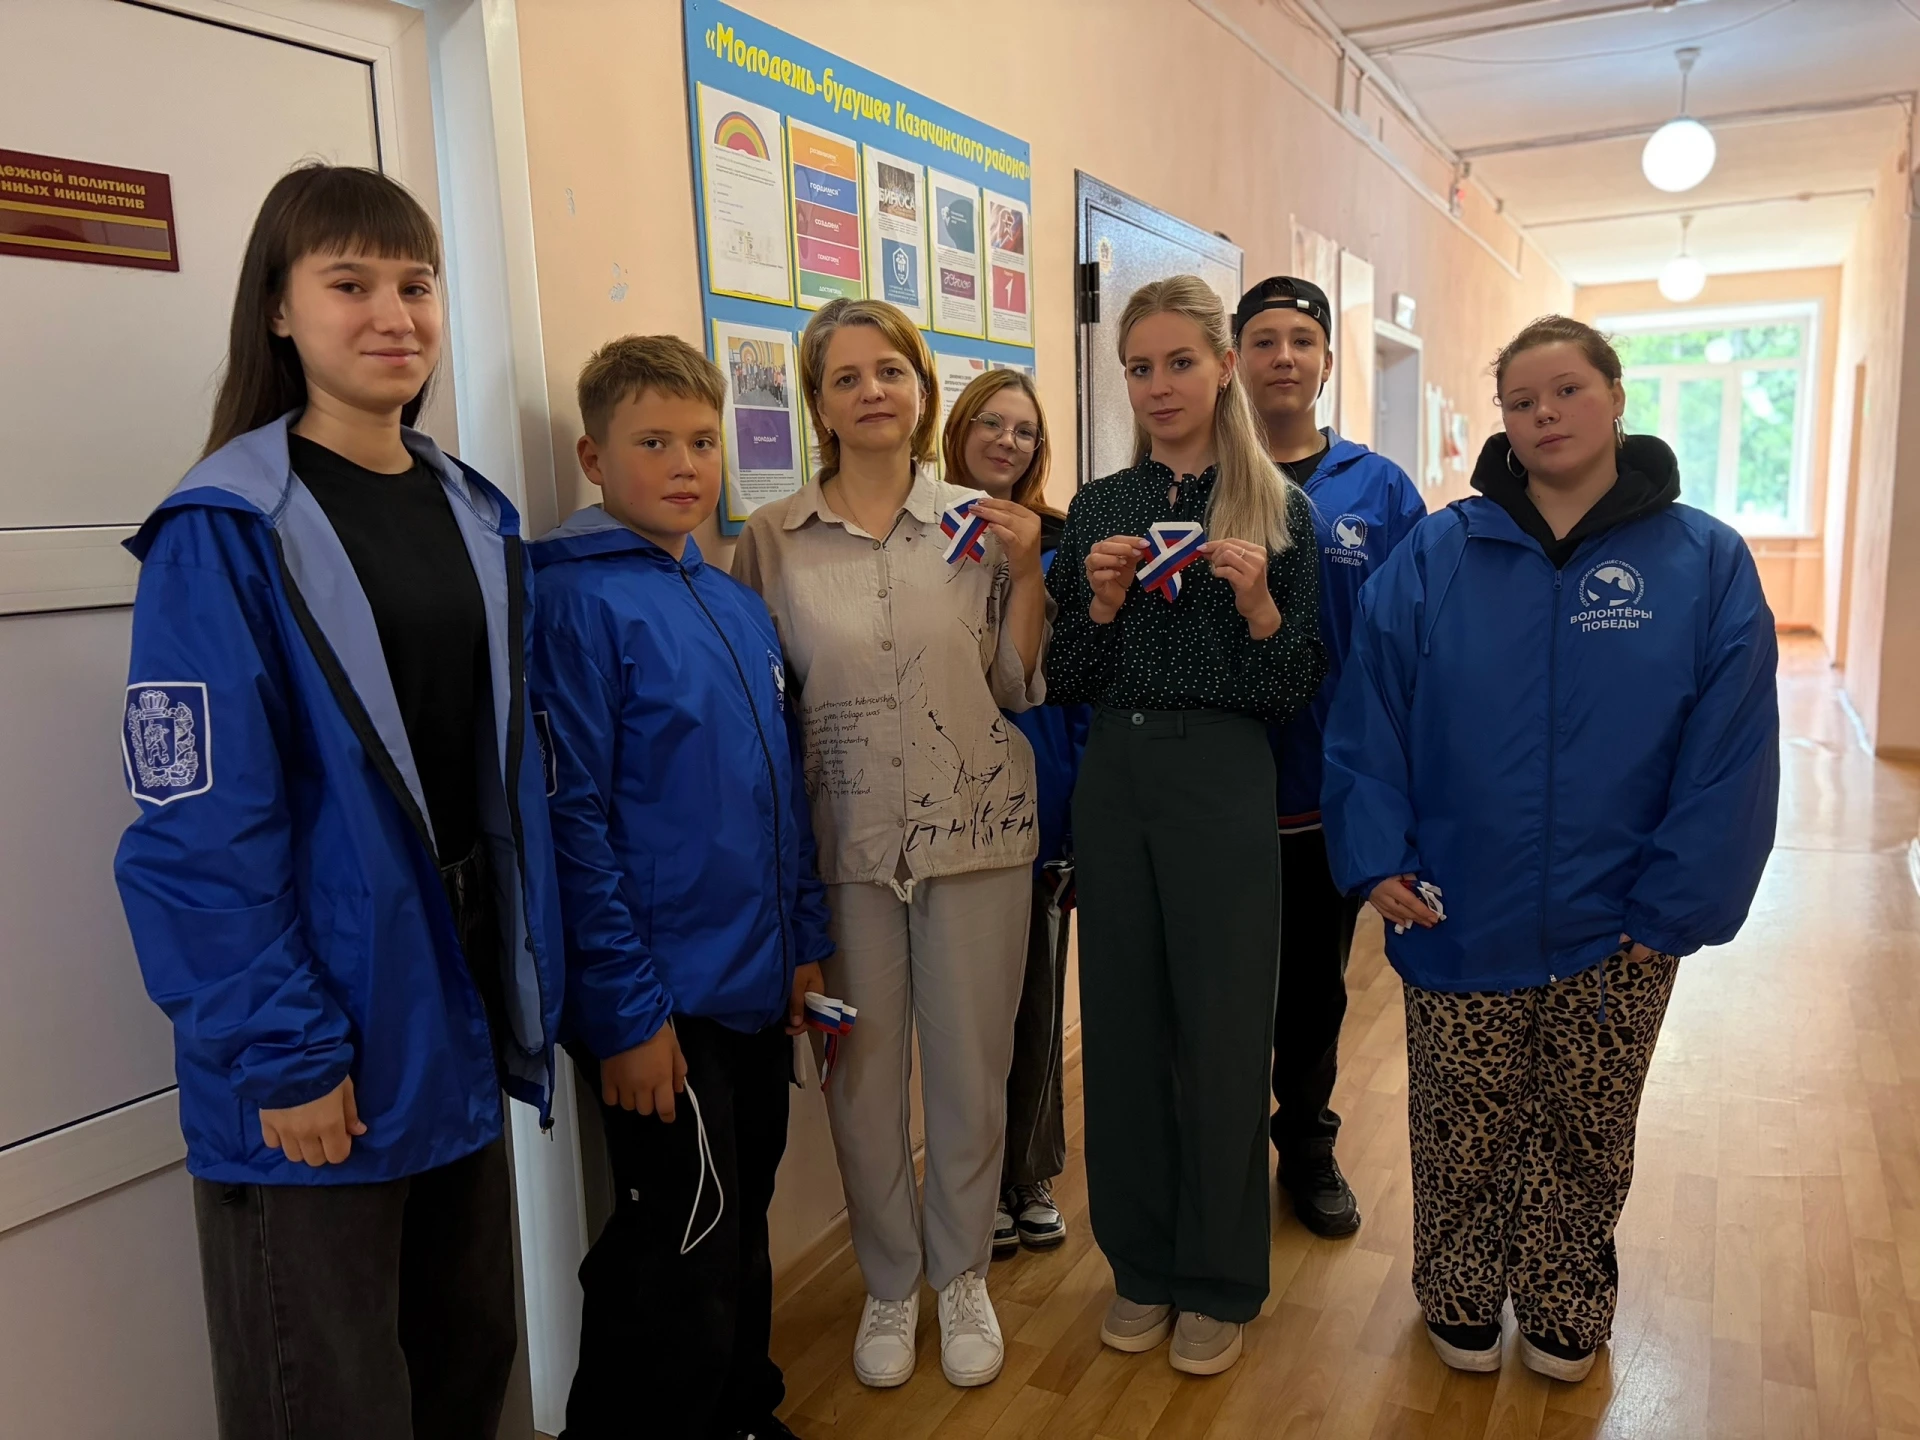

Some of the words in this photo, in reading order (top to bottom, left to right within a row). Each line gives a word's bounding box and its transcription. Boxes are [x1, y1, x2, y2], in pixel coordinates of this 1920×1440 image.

[895, 100, 984, 167] Казачинского
[68, 174, 146, 196] политики
[810, 182, 839, 196] гордимся
[0, 180, 50, 197] нных
[54, 187, 146, 210] инициатив
[1324, 547, 1369, 561] ВОЛОНТЁРЫ
[1331, 555, 1363, 567] ПОБЕДЫ
[1570, 606, 1653, 625] ВОЛОНТЁРЫ
[1581, 619, 1640, 633] ПОБЕДЫ
